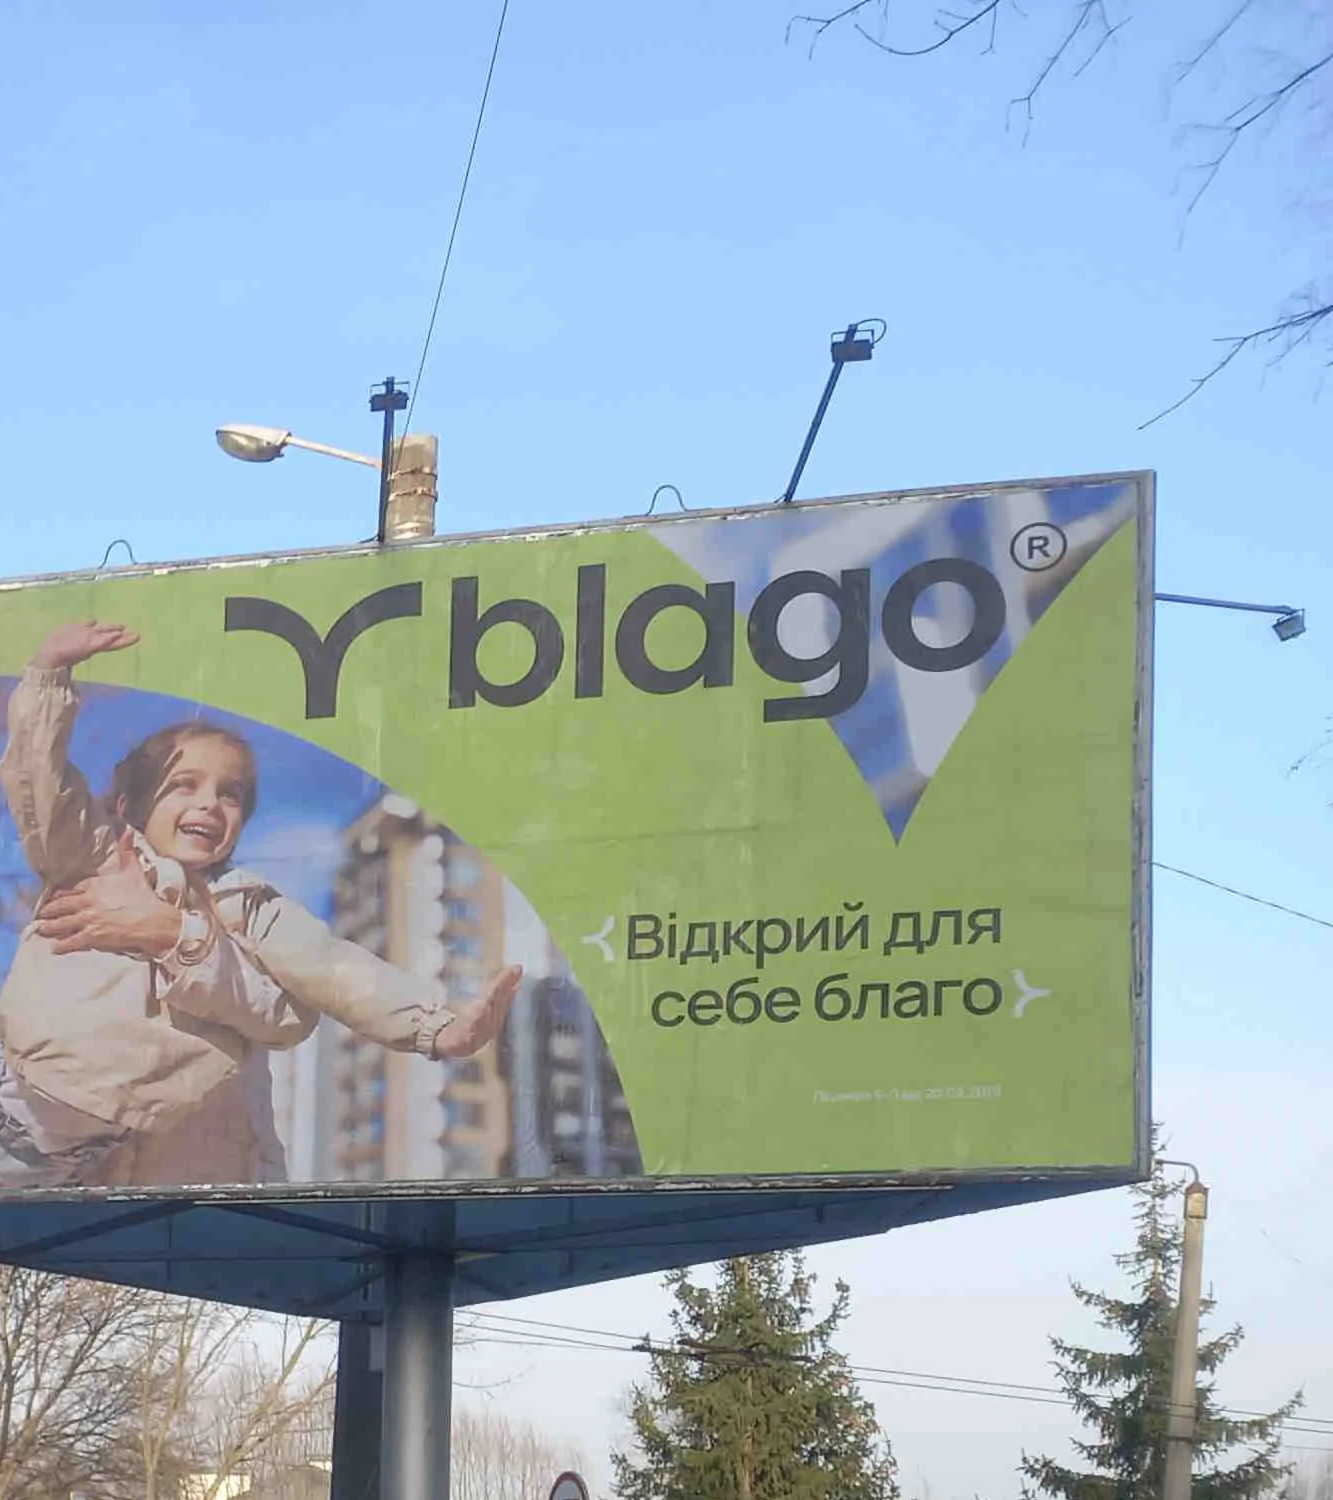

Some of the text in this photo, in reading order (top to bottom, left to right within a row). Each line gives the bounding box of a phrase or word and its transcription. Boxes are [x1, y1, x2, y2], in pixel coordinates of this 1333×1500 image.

[448, 557, 1006, 723] blago
[627, 902, 1001, 969] Відкрий для
[651, 973, 1003, 1027] себе благо
